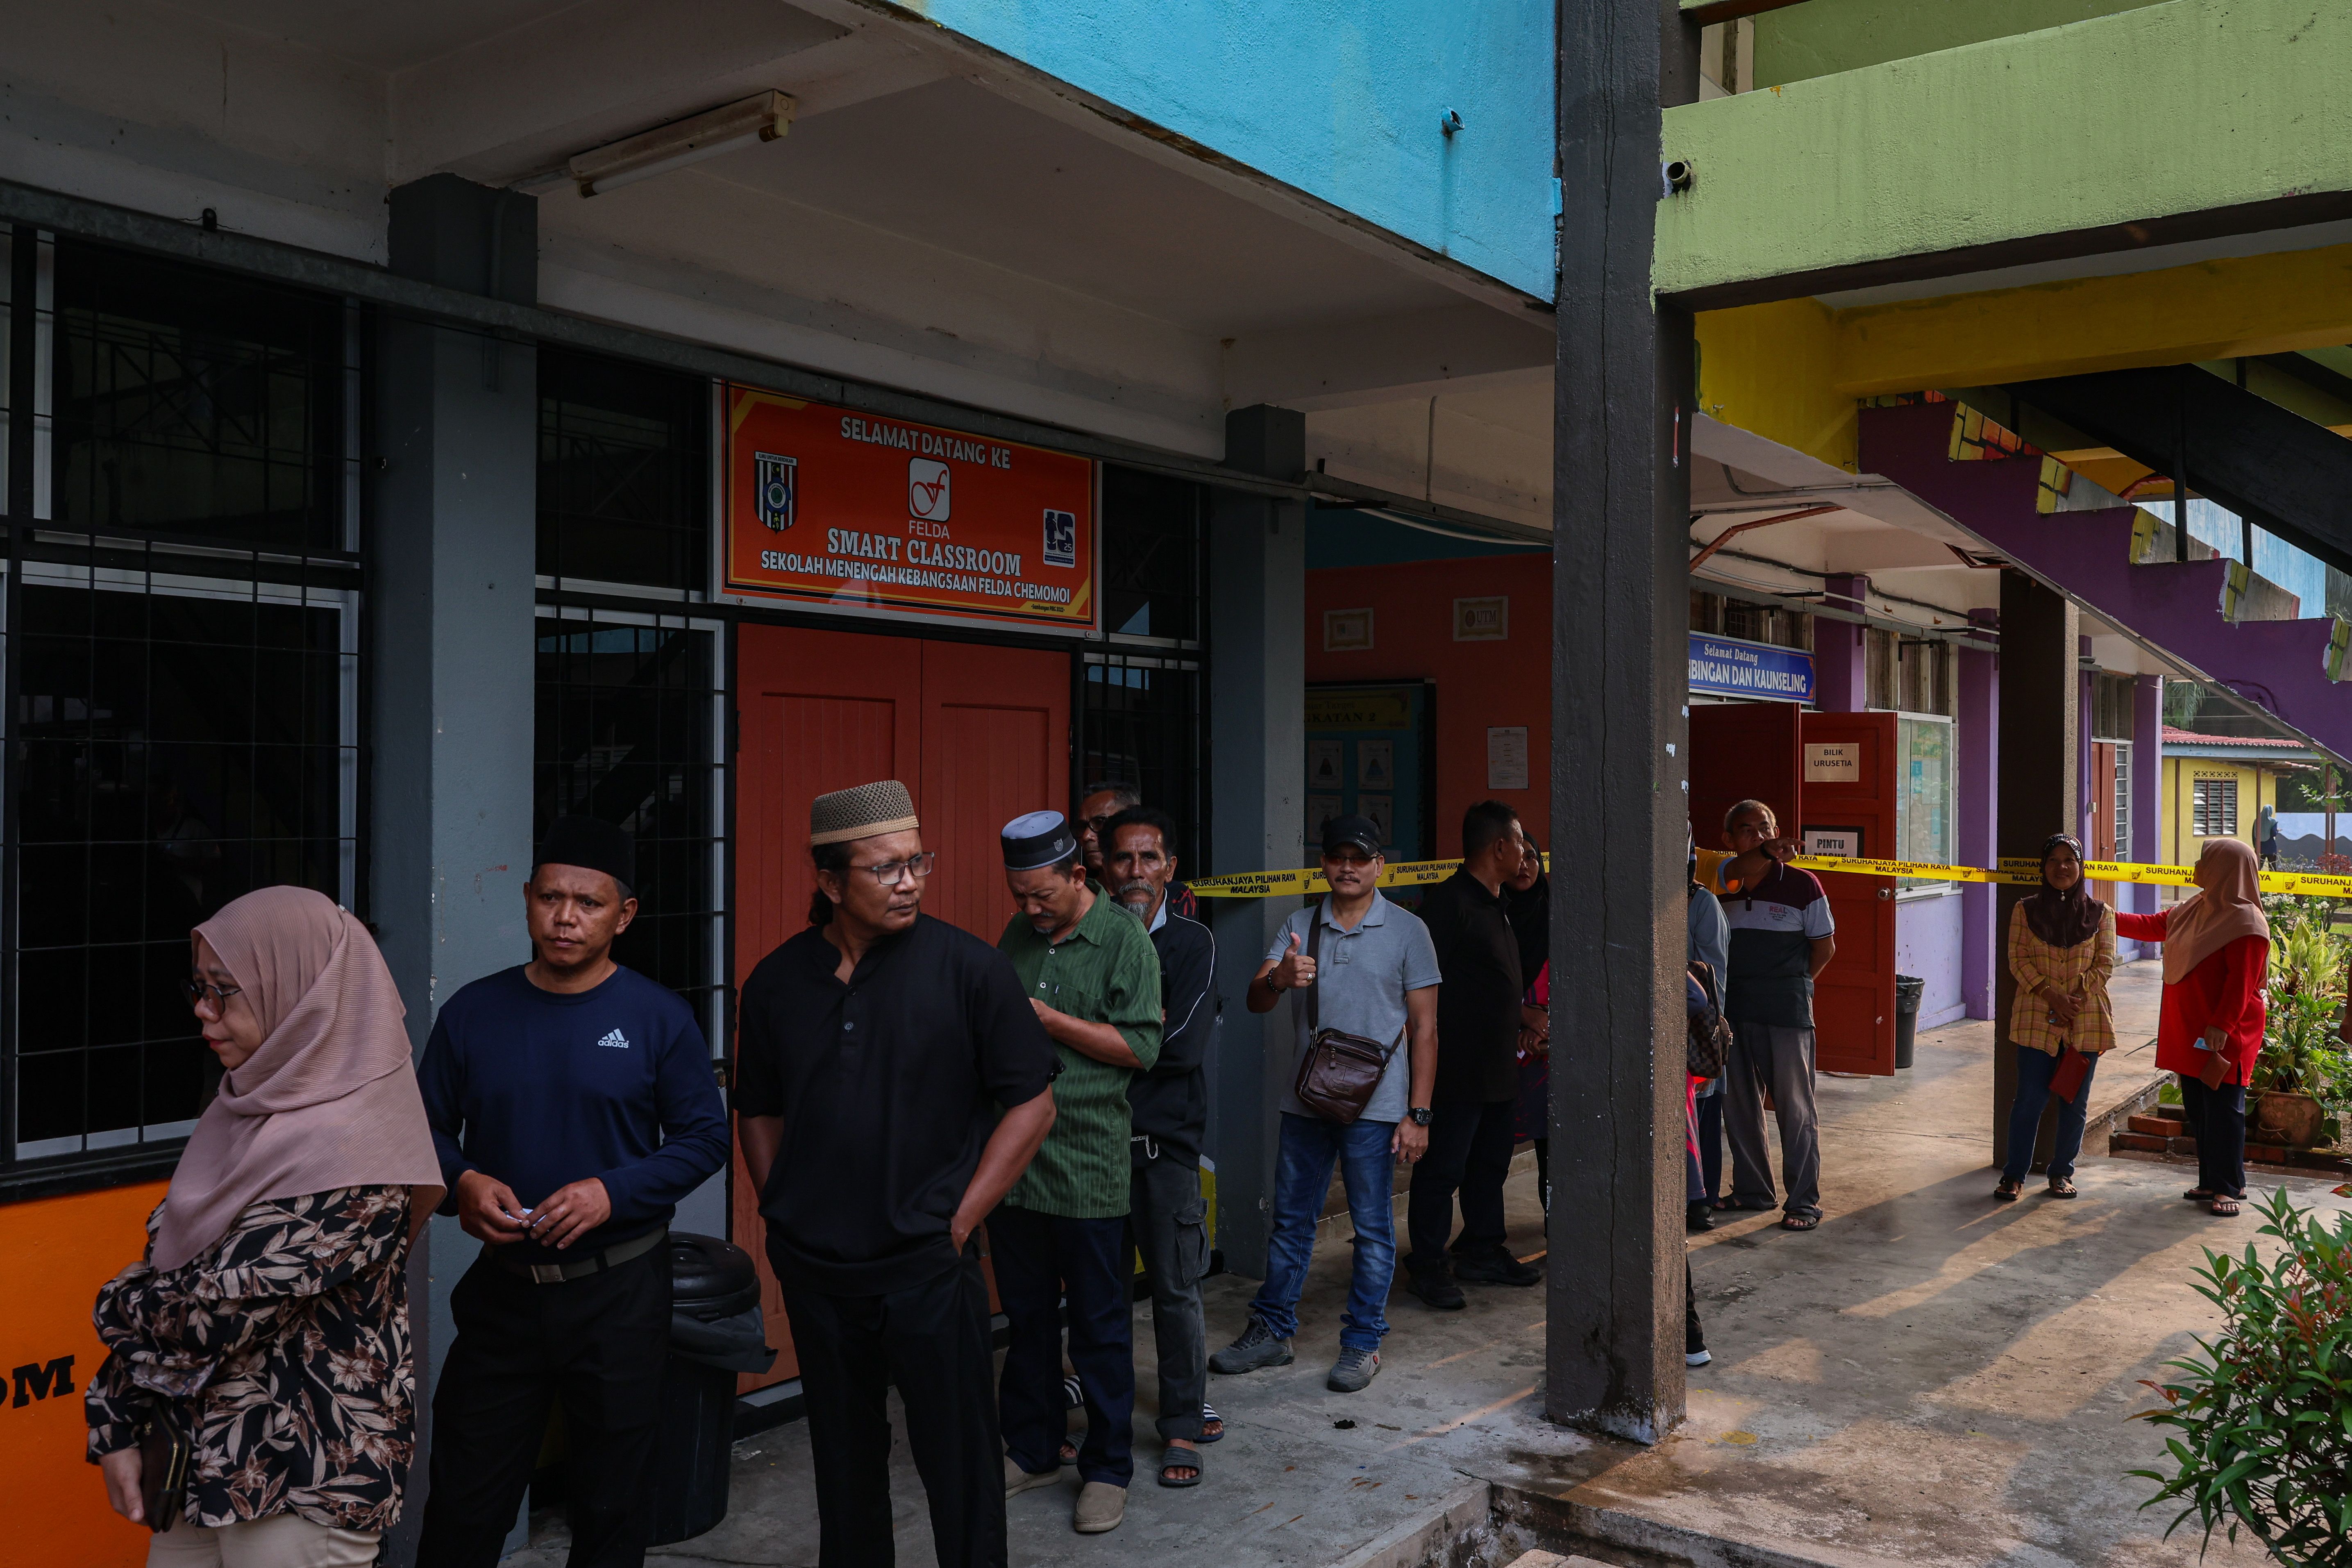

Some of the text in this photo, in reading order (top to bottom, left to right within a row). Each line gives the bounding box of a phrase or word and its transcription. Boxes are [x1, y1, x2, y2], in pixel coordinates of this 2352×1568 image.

[841, 416, 1010, 469] SELAMAT DATANG KE
[909, 520, 950, 540] FELDA
[827, 527, 1021, 576] SMART CLASSROOM
[1064, 543, 1072, 551] 25
[761, 550, 1070, 603] SEKOLAH MENENGAH KEBANGSAAN FELDA CHEMOMOI
[1477, 610, 1496, 622] UTM
[1705, 643, 1758, 666] Selamat Datang
[1689, 659, 1806, 693] BINGAN DAN KAUNSELING
[1369, 712, 1376, 722] 2
[1817, 839, 1844, 849] PINTU
[1396, 861, 1458, 874] SURUHANJAYA PILIHAN RAYA
[1841, 858, 1897, 867] SURUHANJAYA
[1875, 866, 1914, 874] MALAYSIA
[2146, 867, 2195, 876] SURUHANJ
[1192, 873, 1296, 888] SURUHANJAYA PILIHAN RAYA
[1417, 871, 1439, 881] MALAYSIA
[2301, 877, 2352, 886] SURUHANJ
[1230, 885, 1270, 894] MALAYSIA
[598, 1039, 629, 1048] adidas
